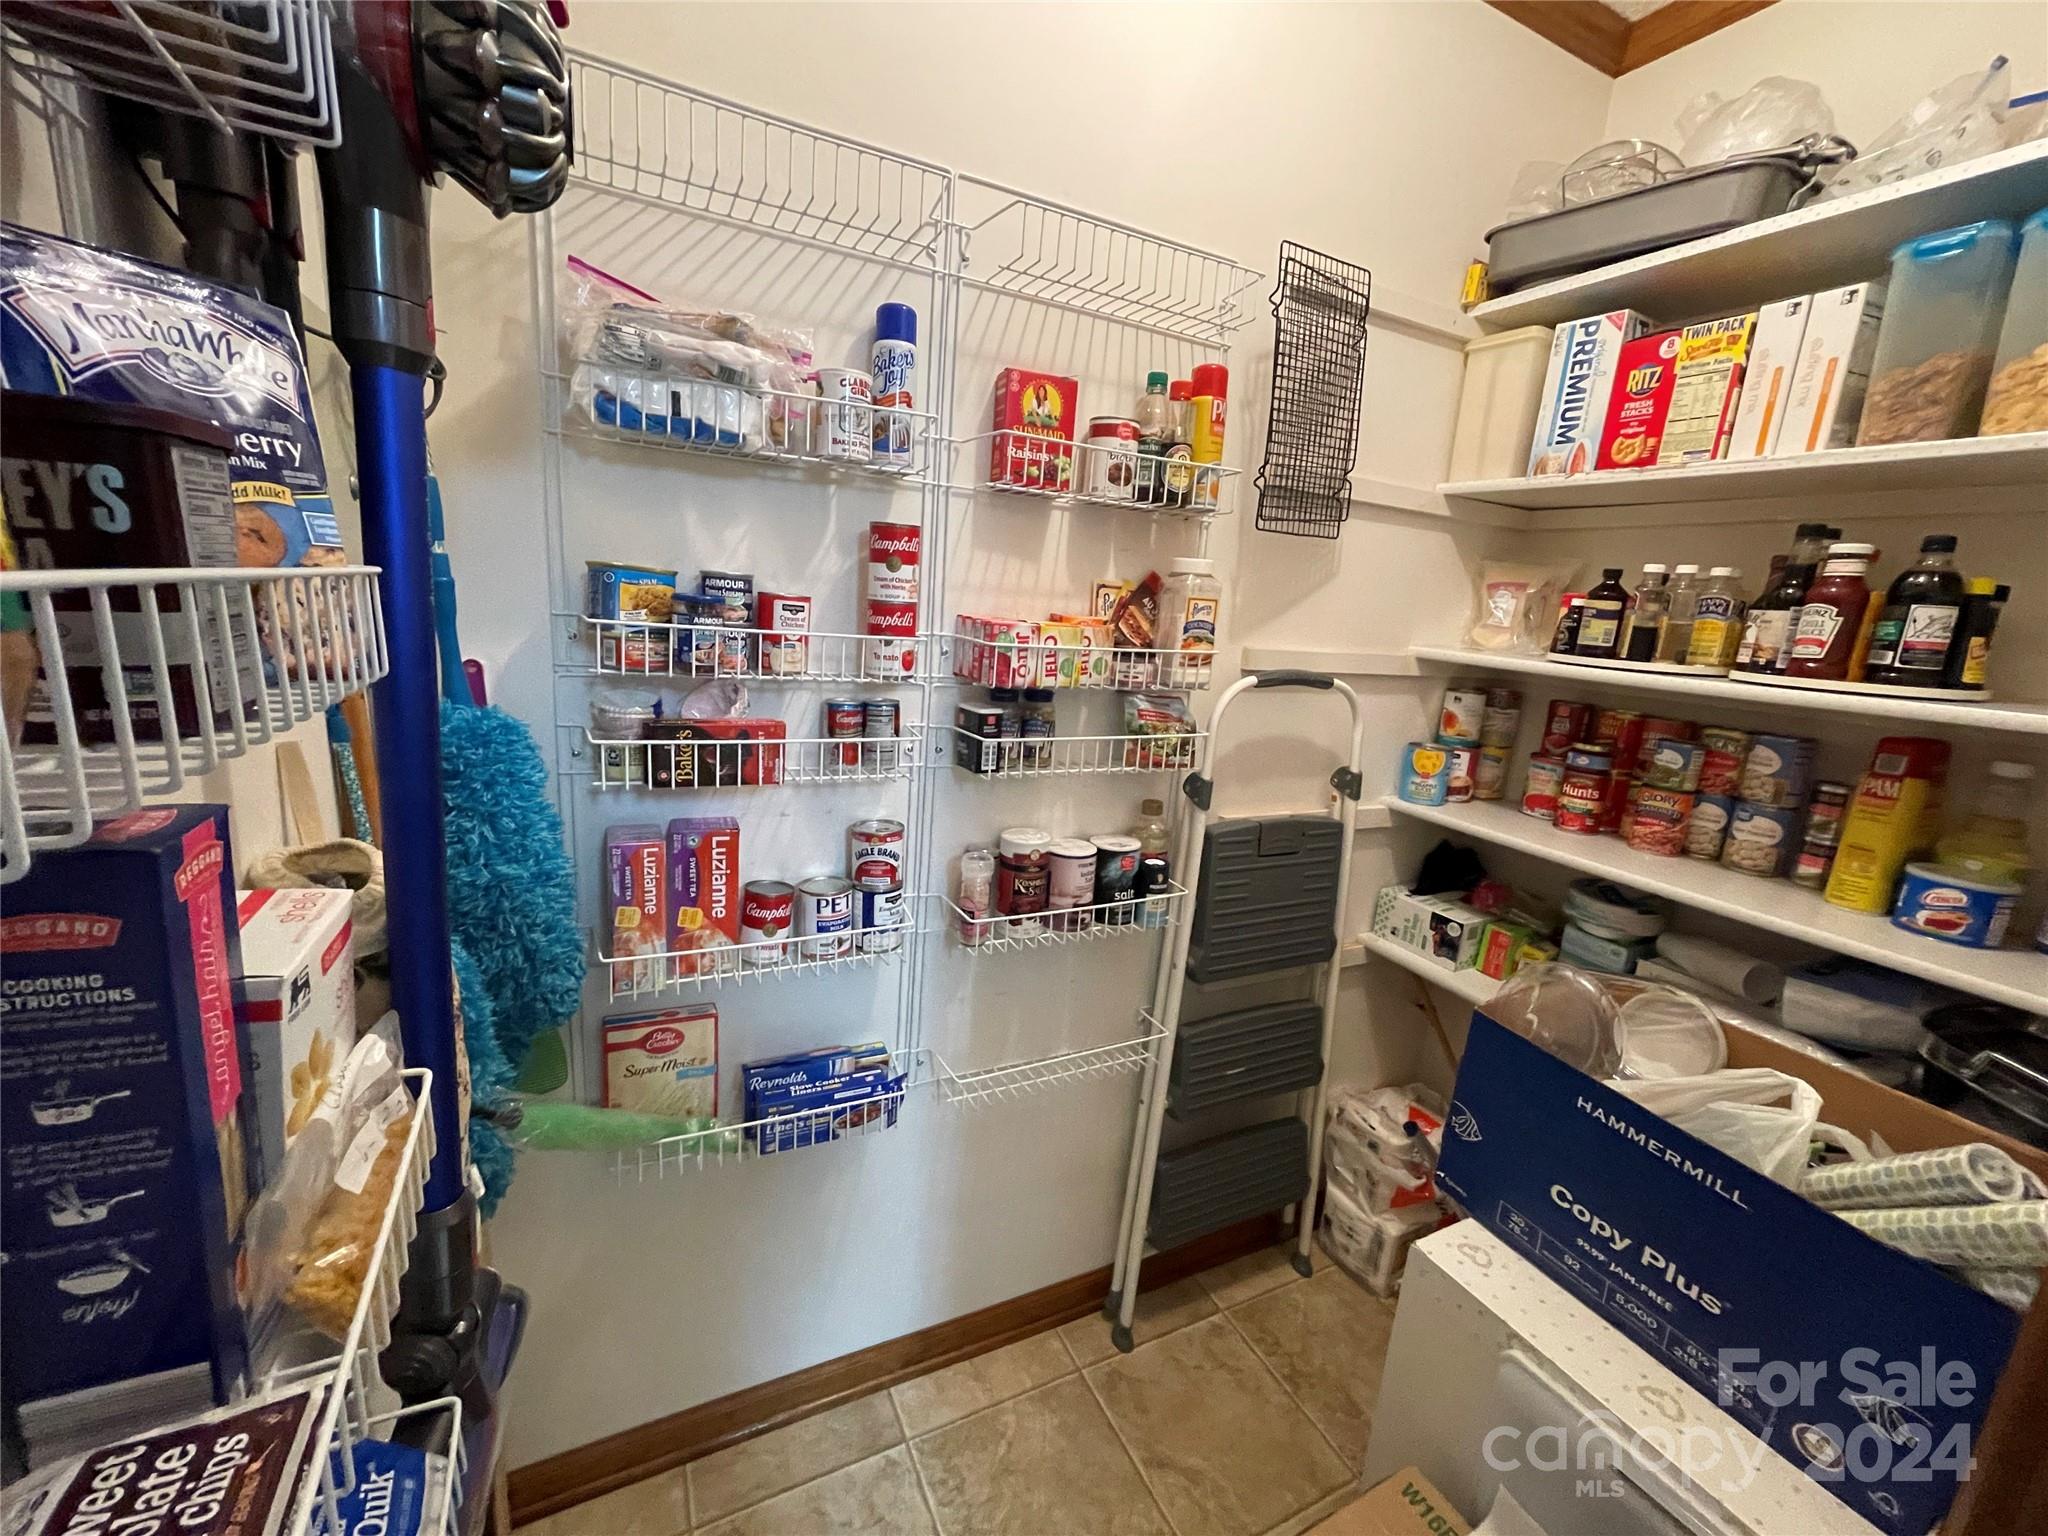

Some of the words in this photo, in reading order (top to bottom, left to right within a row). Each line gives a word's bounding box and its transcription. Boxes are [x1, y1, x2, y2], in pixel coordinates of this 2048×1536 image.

[1685, 325, 1714, 341] TWIN
[1716, 316, 1747, 334] PACK
[181, 317, 289, 391] Whe
[873, 348, 915, 378] Baker's
[839, 374, 872, 391] CLABB
[1555, 319, 1601, 446] PREMIUM
[1626, 365, 1664, 393] RITZ
[850, 386, 870, 399] GIRL
[1620, 407, 1655, 419] STACKS
[1624, 398, 1654, 411] FRESH
[233, 431, 302, 468] erry
[1007, 445, 1050, 462] Raisins
[241, 455, 268, 470] Mix
[252, 484, 287, 500] Milk!
[704, 578, 745, 589] ARMOUR
[873, 651, 900, 663] Toato
[1862, 776, 1901, 798] PAM
[855, 847, 876, 861] EAGLE
[876, 847, 901, 863] BRAND
[689, 857, 697, 883] SWEET
[711, 836, 731, 919] Luzianne
[643, 847, 660, 915] Luzianne
[689, 883, 697, 898] TEA
[816, 894, 851, 915] PET
[1113, 888, 1135, 900] salt
[2, 974, 104, 995] COOKING
[750, 1071, 808, 1093] Reynolds
[789, 1083, 813, 1092] Slow
[815, 1075, 850, 1087] Cooker
[790, 1086, 822, 1097] Liners
[1575, 1095, 1751, 1211] HAMMERMILL
[1549, 1183, 1633, 1251] Copy
[1639, 1244, 1724, 1316] Plus
[1562, 1253, 1581, 1271] 92
[1608, 1260, 1674, 1313] JAM-FREE
[173, 1432, 252, 1526] chips
